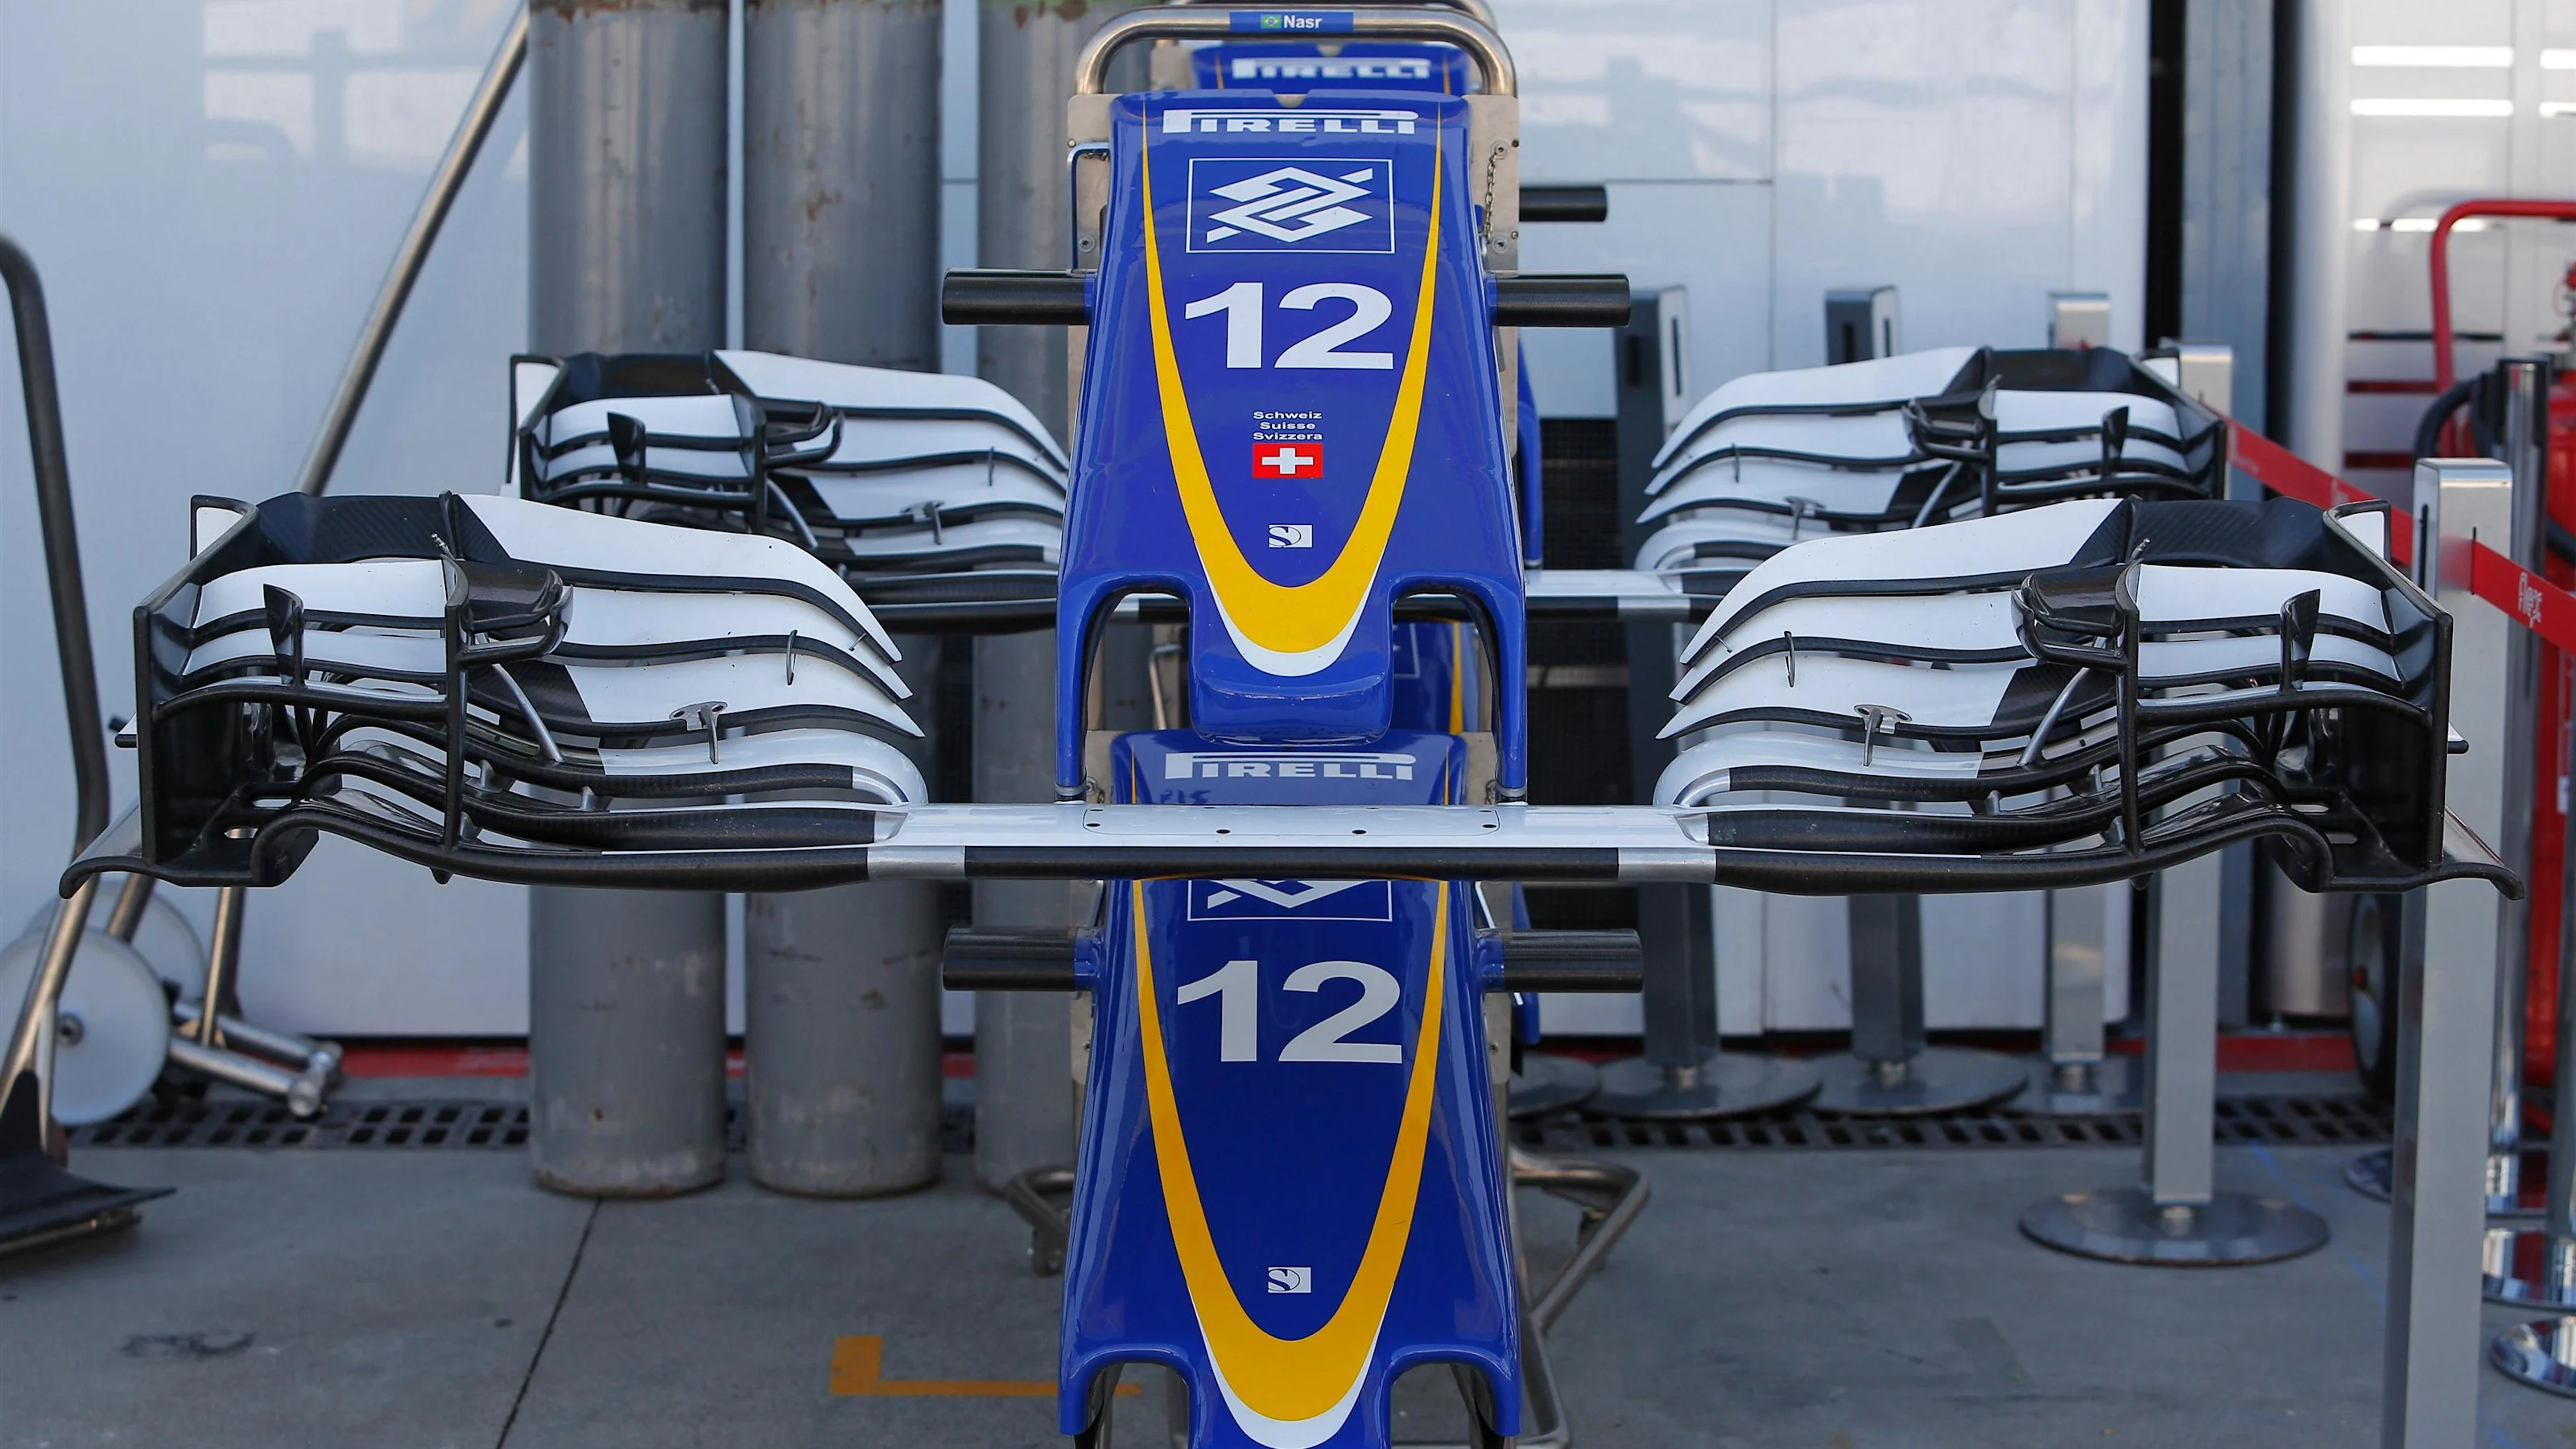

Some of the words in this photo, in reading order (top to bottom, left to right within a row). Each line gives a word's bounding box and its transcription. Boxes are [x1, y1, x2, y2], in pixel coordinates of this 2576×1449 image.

[1283, 14, 1323, 29] Nasr
[1232, 58, 1430, 79] PIRELLI
[1162, 109, 1419, 134] PIRELLI
[1185, 282, 1394, 370] 12
[1253, 411, 1323, 419] Schweiz
[1259, 421, 1316, 430] Suisse
[1253, 431, 1323, 440] Svizzera
[1165, 752, 1417, 781] PIRELLI
[1177, 960, 1403, 1064] 12
